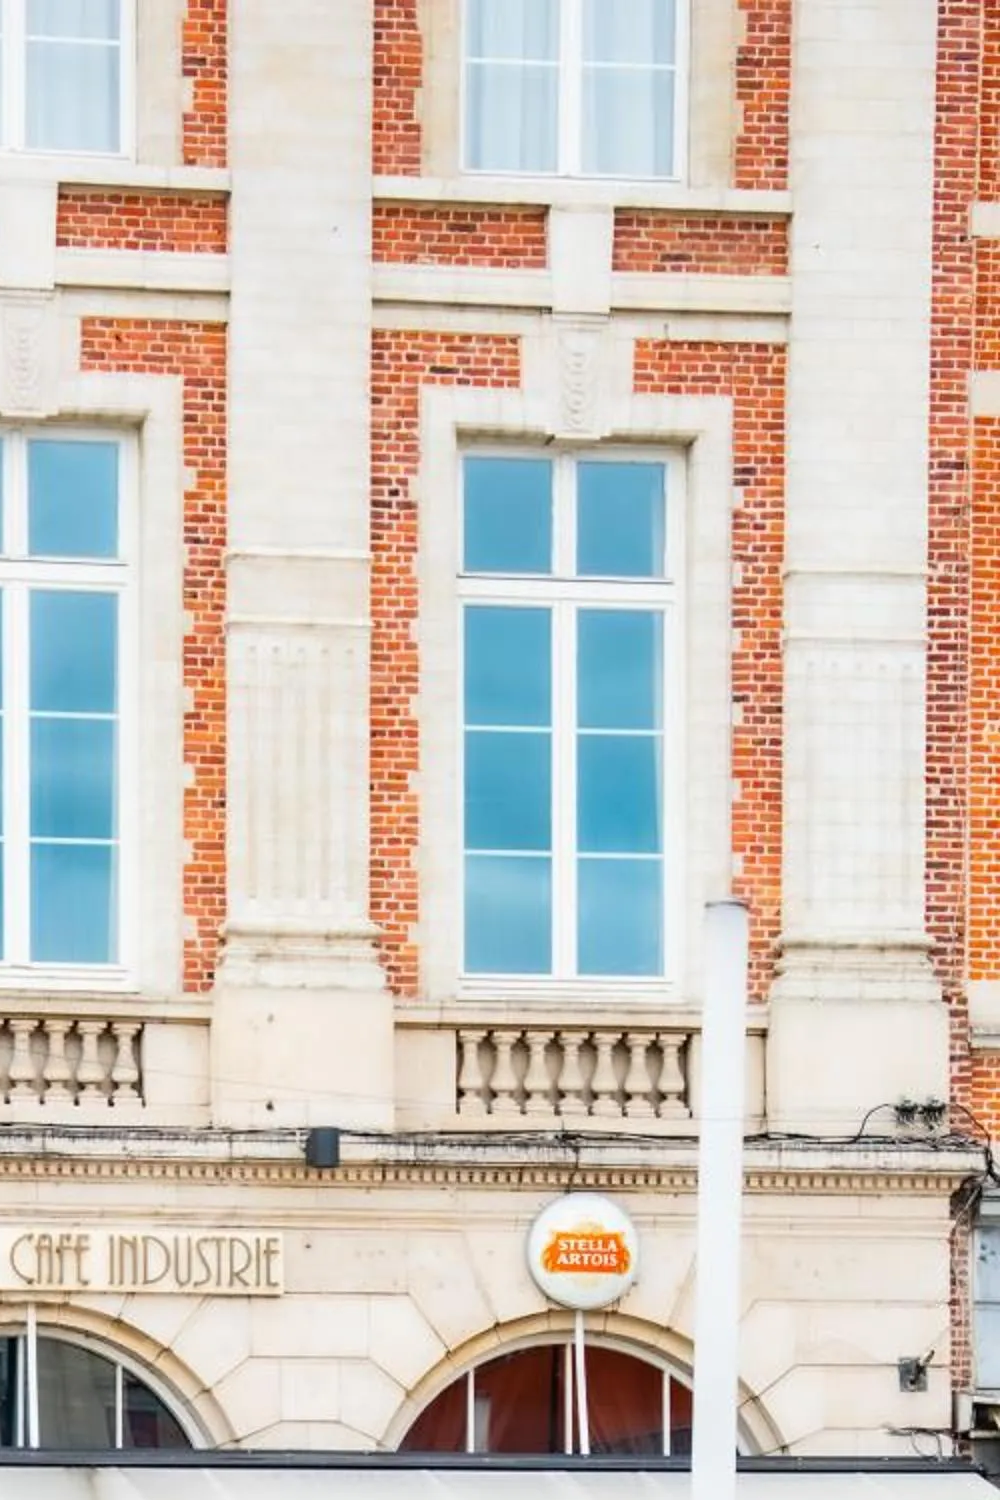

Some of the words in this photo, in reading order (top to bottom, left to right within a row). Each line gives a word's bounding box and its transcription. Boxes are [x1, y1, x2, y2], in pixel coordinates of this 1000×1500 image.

[558, 1239, 617, 1253] STELLA
[9, 1233, 90, 1286] CAFE
[108, 1233, 280, 1288] INDUSTRIE
[557, 1253, 618, 1267] ARTOIS
